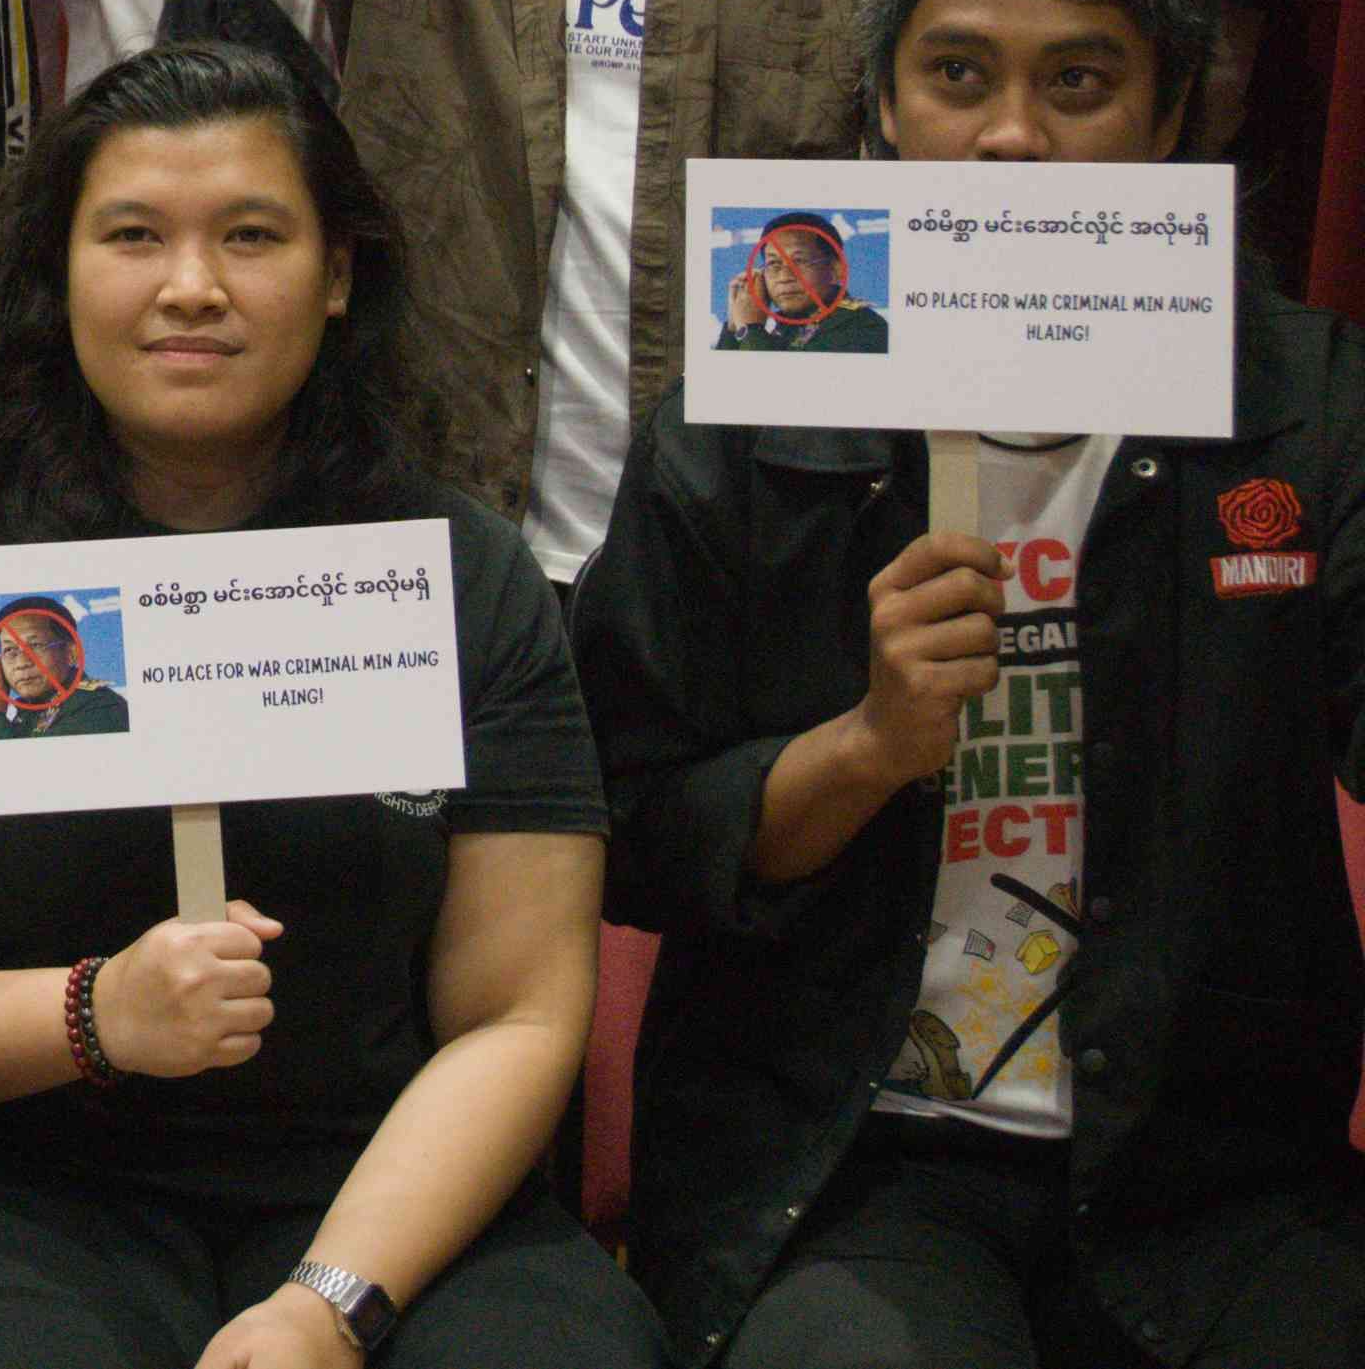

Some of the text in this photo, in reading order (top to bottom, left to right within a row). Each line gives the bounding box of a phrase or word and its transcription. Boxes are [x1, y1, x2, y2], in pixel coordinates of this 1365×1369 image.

[984, 210, 1123, 245] မင်းအောင်လှိုင်
[1130, 212, 1209, 246] အလိုမရှိ
[906, 292, 1213, 313] NO PLACE FOR WAR CRIMINAL MIN AUNG
[1027, 324, 1089, 342] HLAING!
[213, 572, 348, 607] မင်းအောင်လှိုင်
[354, 568, 430, 602] အလိုမရှိ
[1220, 553, 1308, 589] MANDIRI
[143, 650, 439, 684] NO PLACE FOR WAR CRIMINAL MIN AUNG
[262, 687, 323, 707] HLAING!
